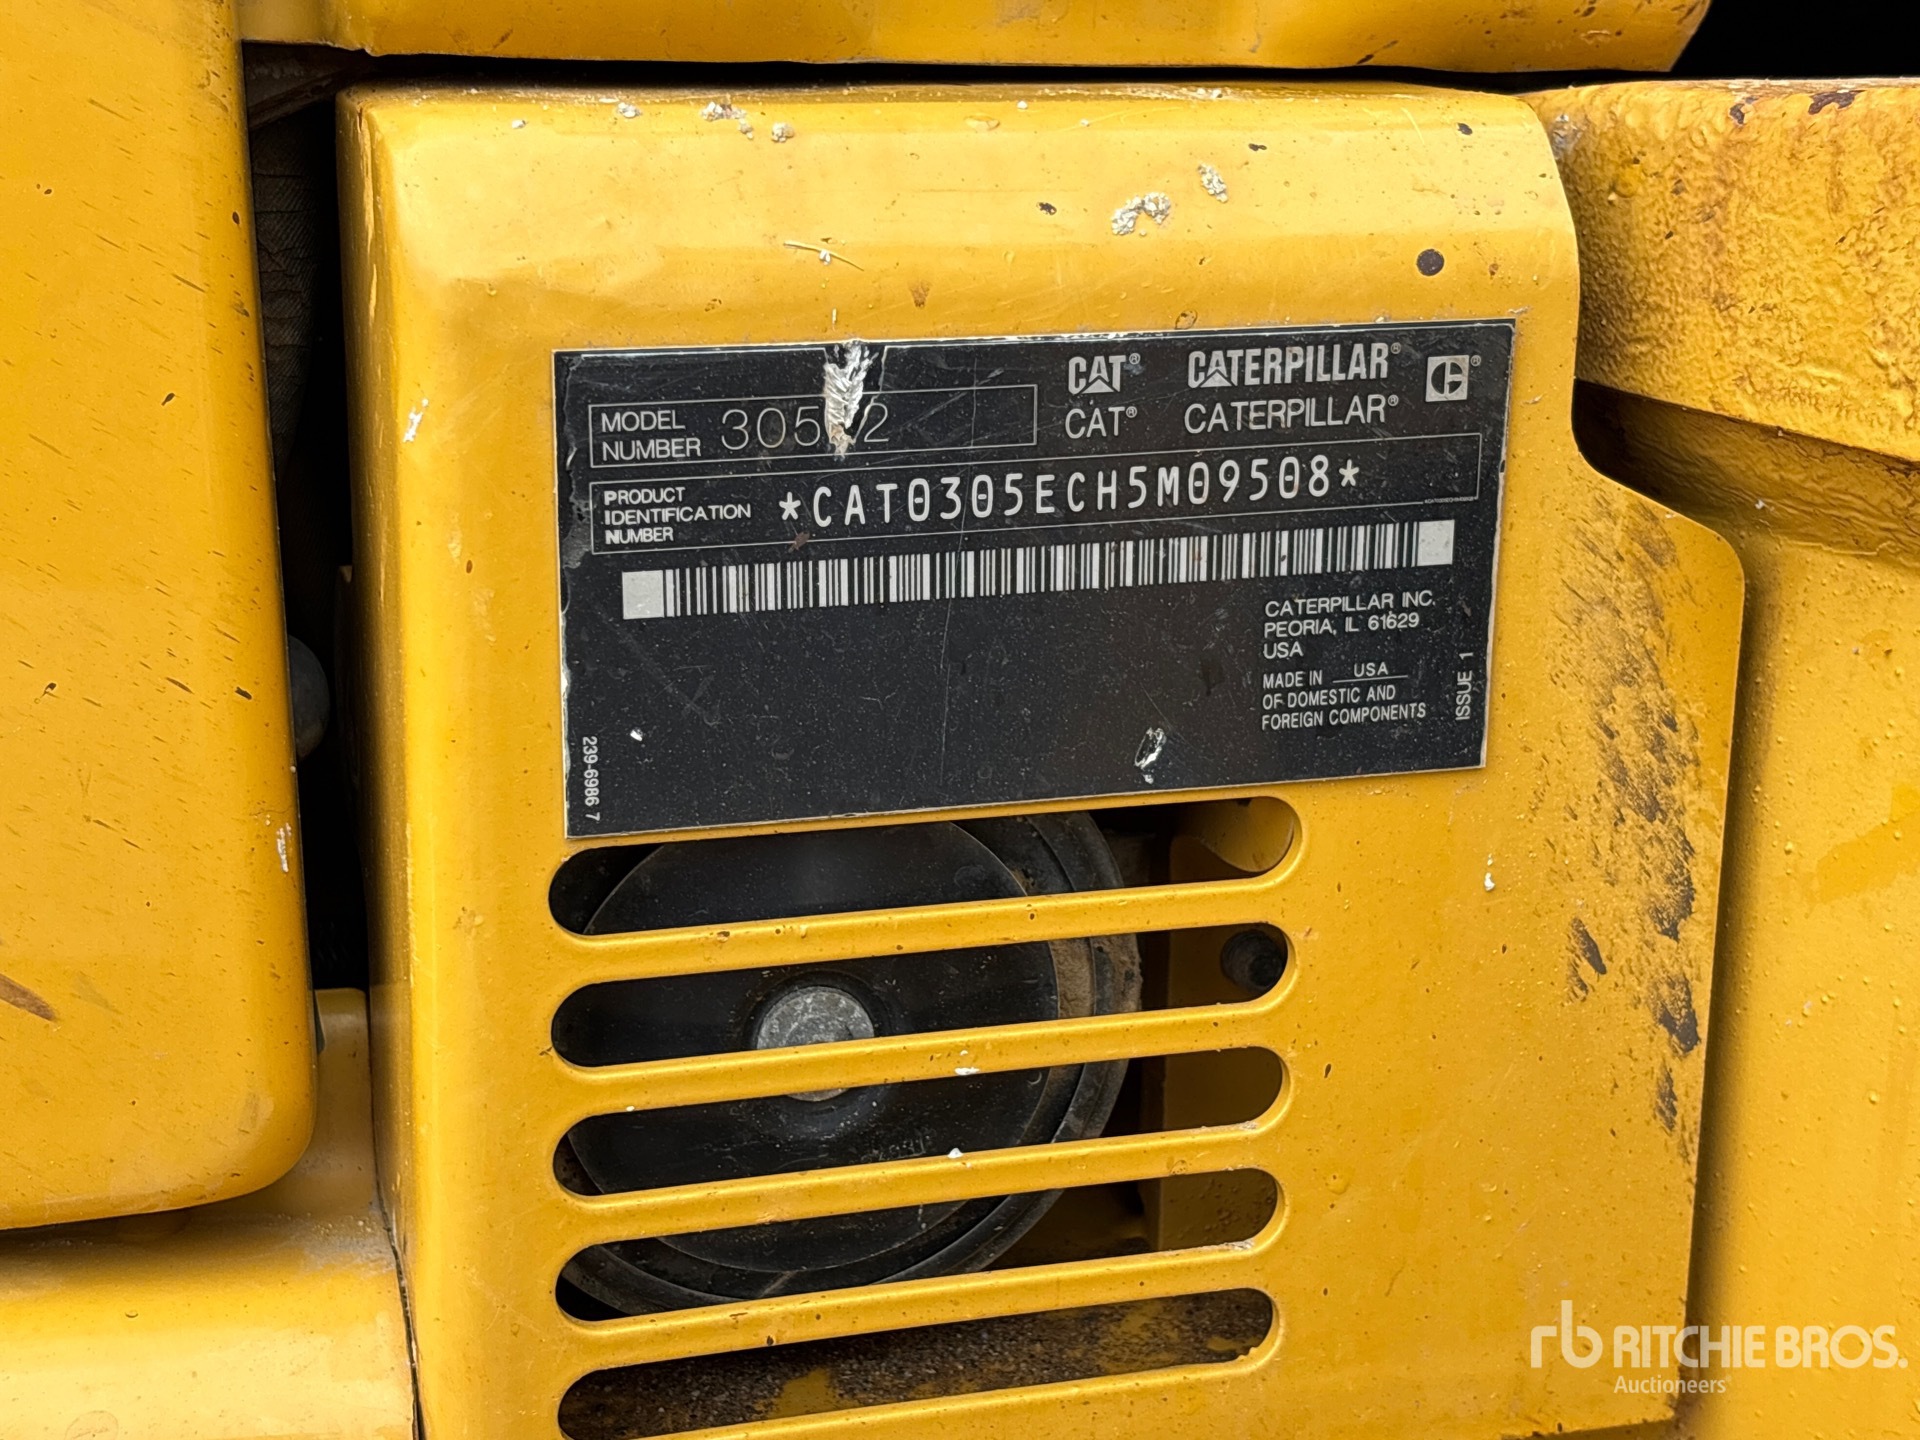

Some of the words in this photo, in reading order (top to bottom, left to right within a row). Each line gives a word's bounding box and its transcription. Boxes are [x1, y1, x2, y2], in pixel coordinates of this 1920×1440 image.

[601, 410, 686, 433] MODEL
[721, 402, 889, 450] 3052
[602, 437, 701, 462] NUMBER
[604, 486, 686, 505] PRODUCT
[604, 503, 751, 526] IDENTIFICATION
[605, 526, 674, 545] NUMBER
[1264, 592, 1394, 618] CATERPILLAR
[1401, 590, 1436, 608] INC.
[1264, 618, 1337, 639] PEORIA,
[1344, 616, 1360, 633] IL
[1367, 612, 1420, 632] 61629
[1263, 641, 1304, 659] USA
[1458, 652, 1474, 660] 1
[1262, 670, 1304, 690] MADE
[1309, 669, 1323, 686] IN
[1353, 662, 1389, 678] USA
[1262, 693, 1283, 711] OF
[1287, 686, 1361, 708] DOMESTIC
[1366, 684, 1396, 702] AND
[1455, 669, 1473, 720] ISSUE
[1261, 710, 1324, 731] FOREIGN
[1328, 702, 1427, 726] COMPONENTS
[582, 735, 600, 807] 239-6986
[585, 812, 600, 821] 7
